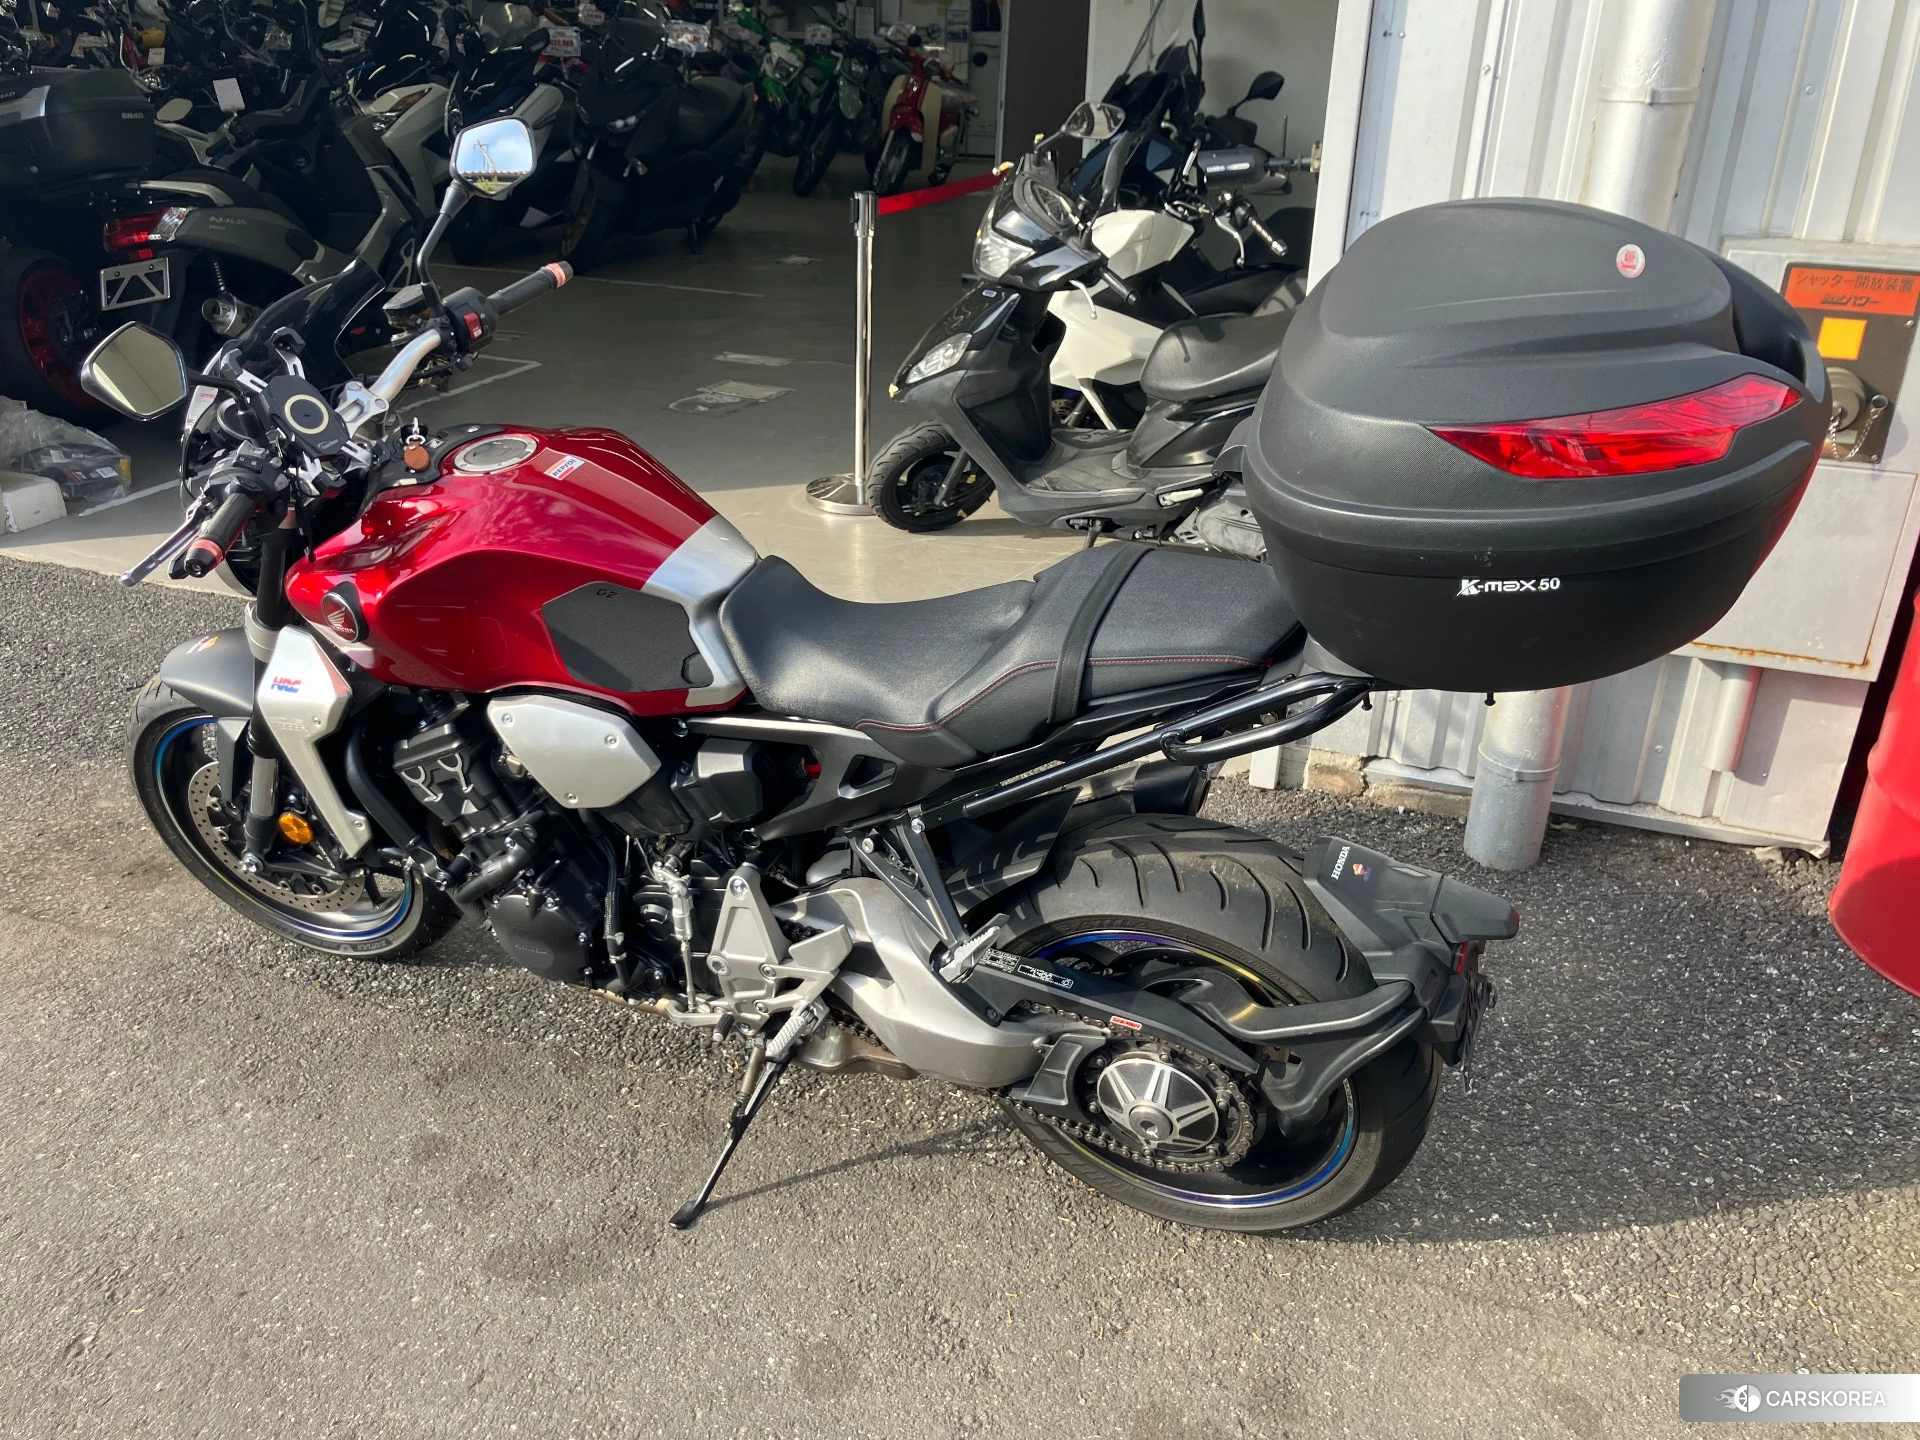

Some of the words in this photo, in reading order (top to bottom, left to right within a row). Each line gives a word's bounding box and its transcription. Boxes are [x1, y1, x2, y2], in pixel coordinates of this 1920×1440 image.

[1796, 270, 1915, 293] シャッター開放装置
[270, 675, 303, 693] HRC
[1330, 845, 1351, 881] HONDA
